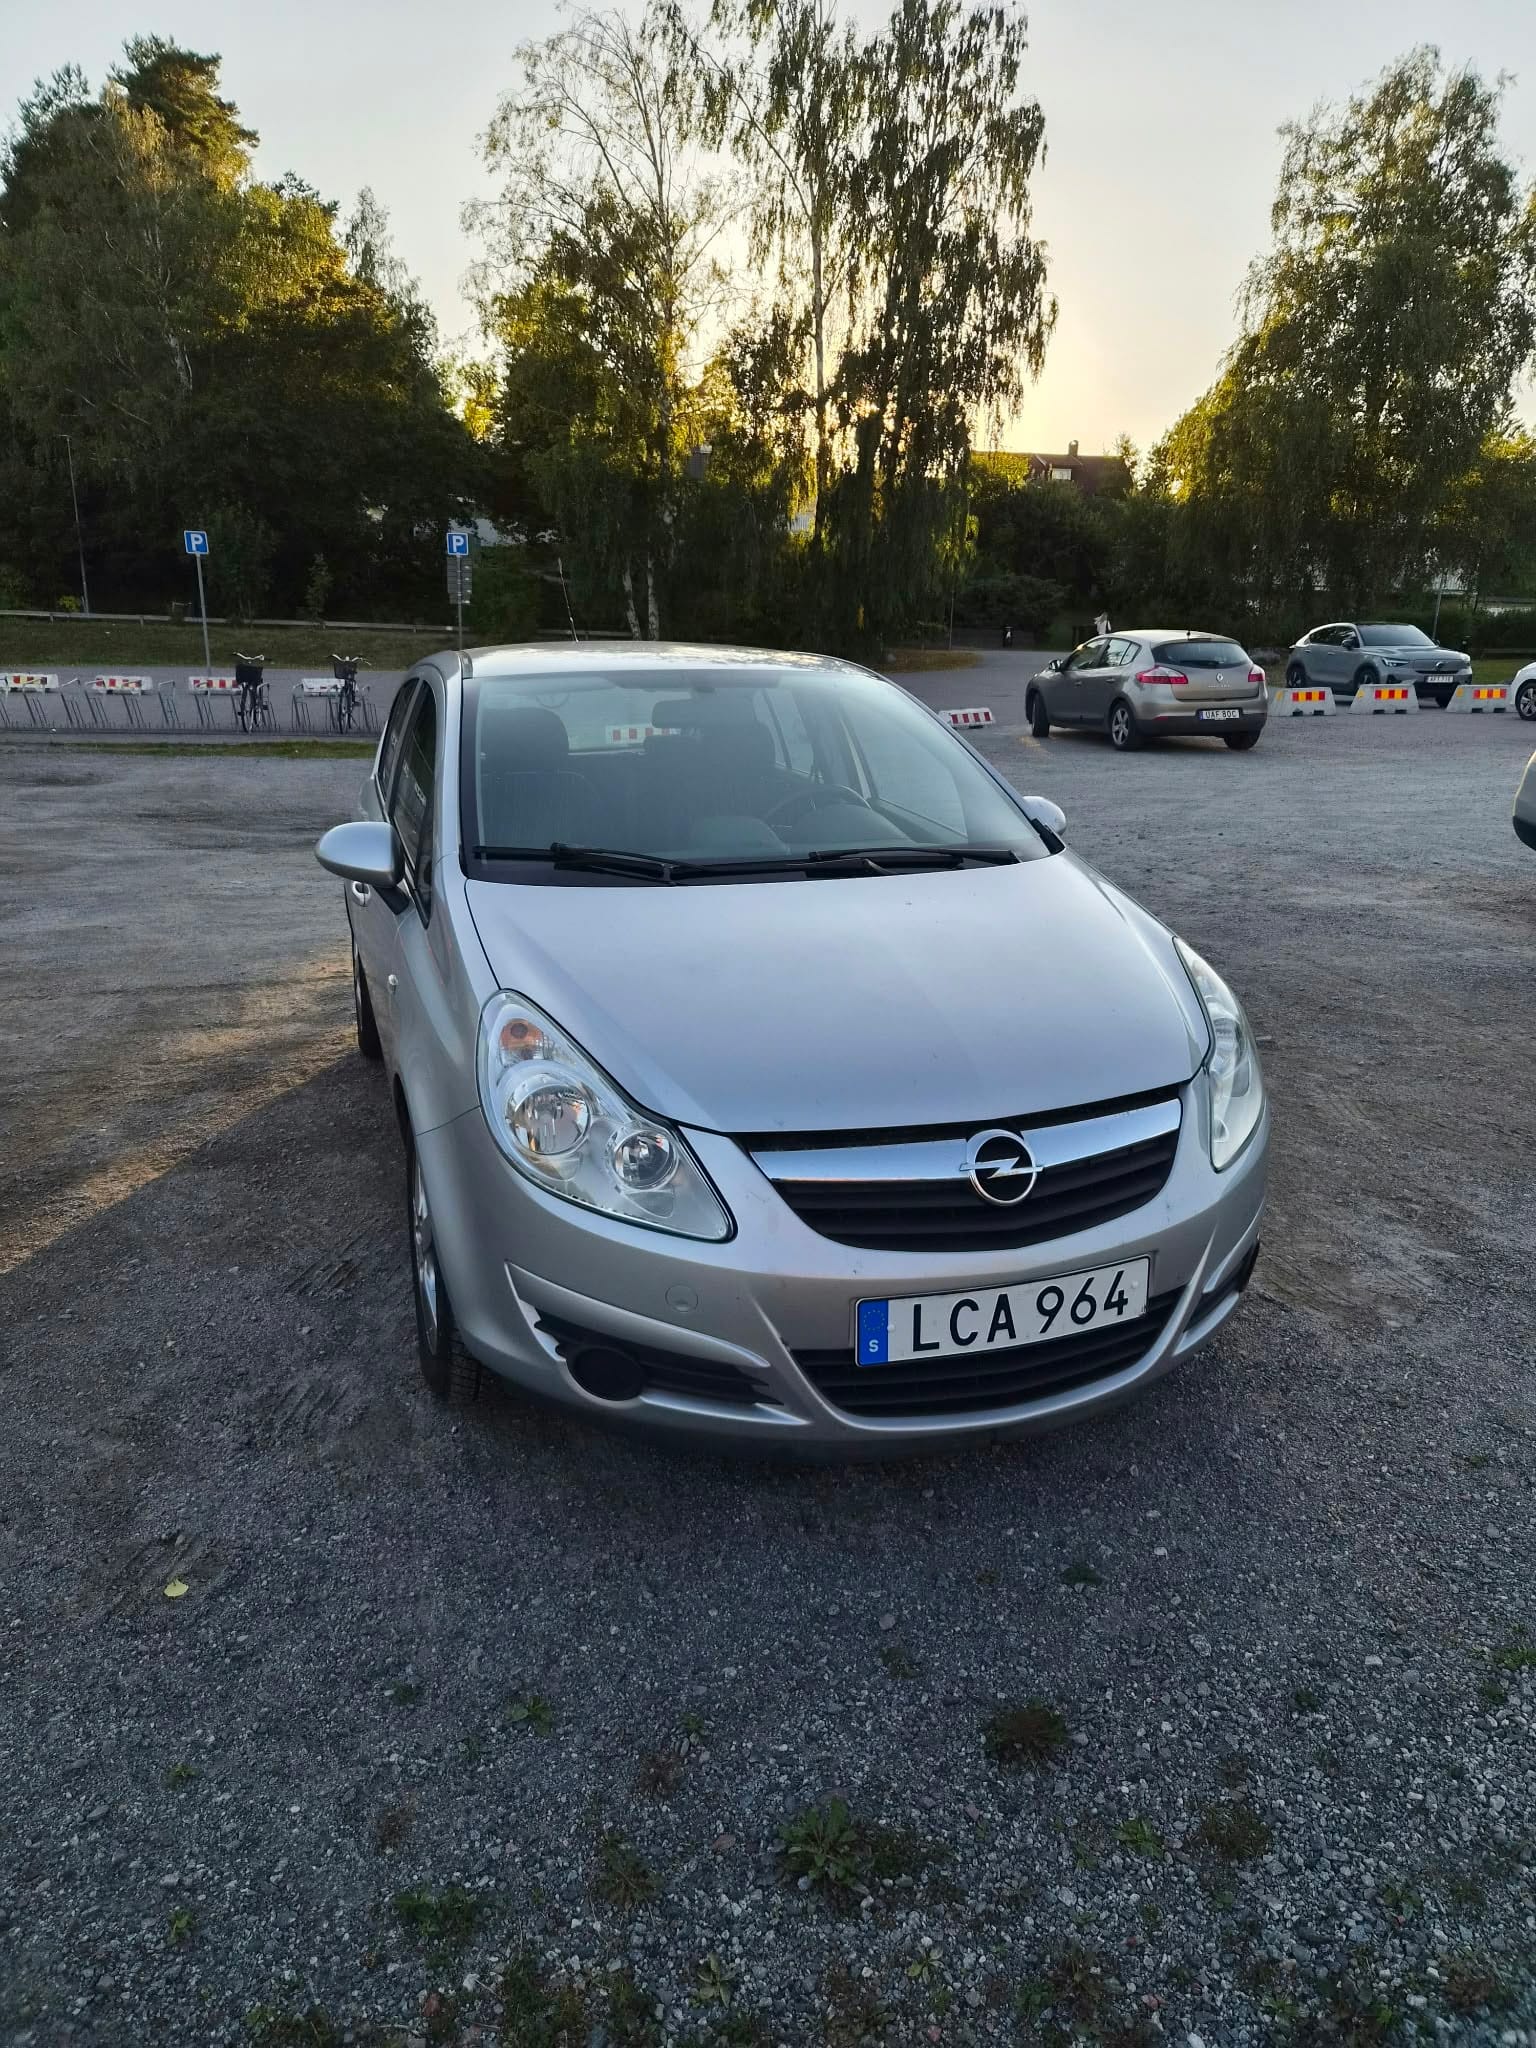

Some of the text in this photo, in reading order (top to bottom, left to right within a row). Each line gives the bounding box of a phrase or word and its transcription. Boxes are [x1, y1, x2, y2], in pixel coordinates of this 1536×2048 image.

[190, 533, 204, 551] P
[452, 535, 465, 553] P
[912, 1269, 1129, 1353] LCA 964
[868, 1339, 880, 1353] S
